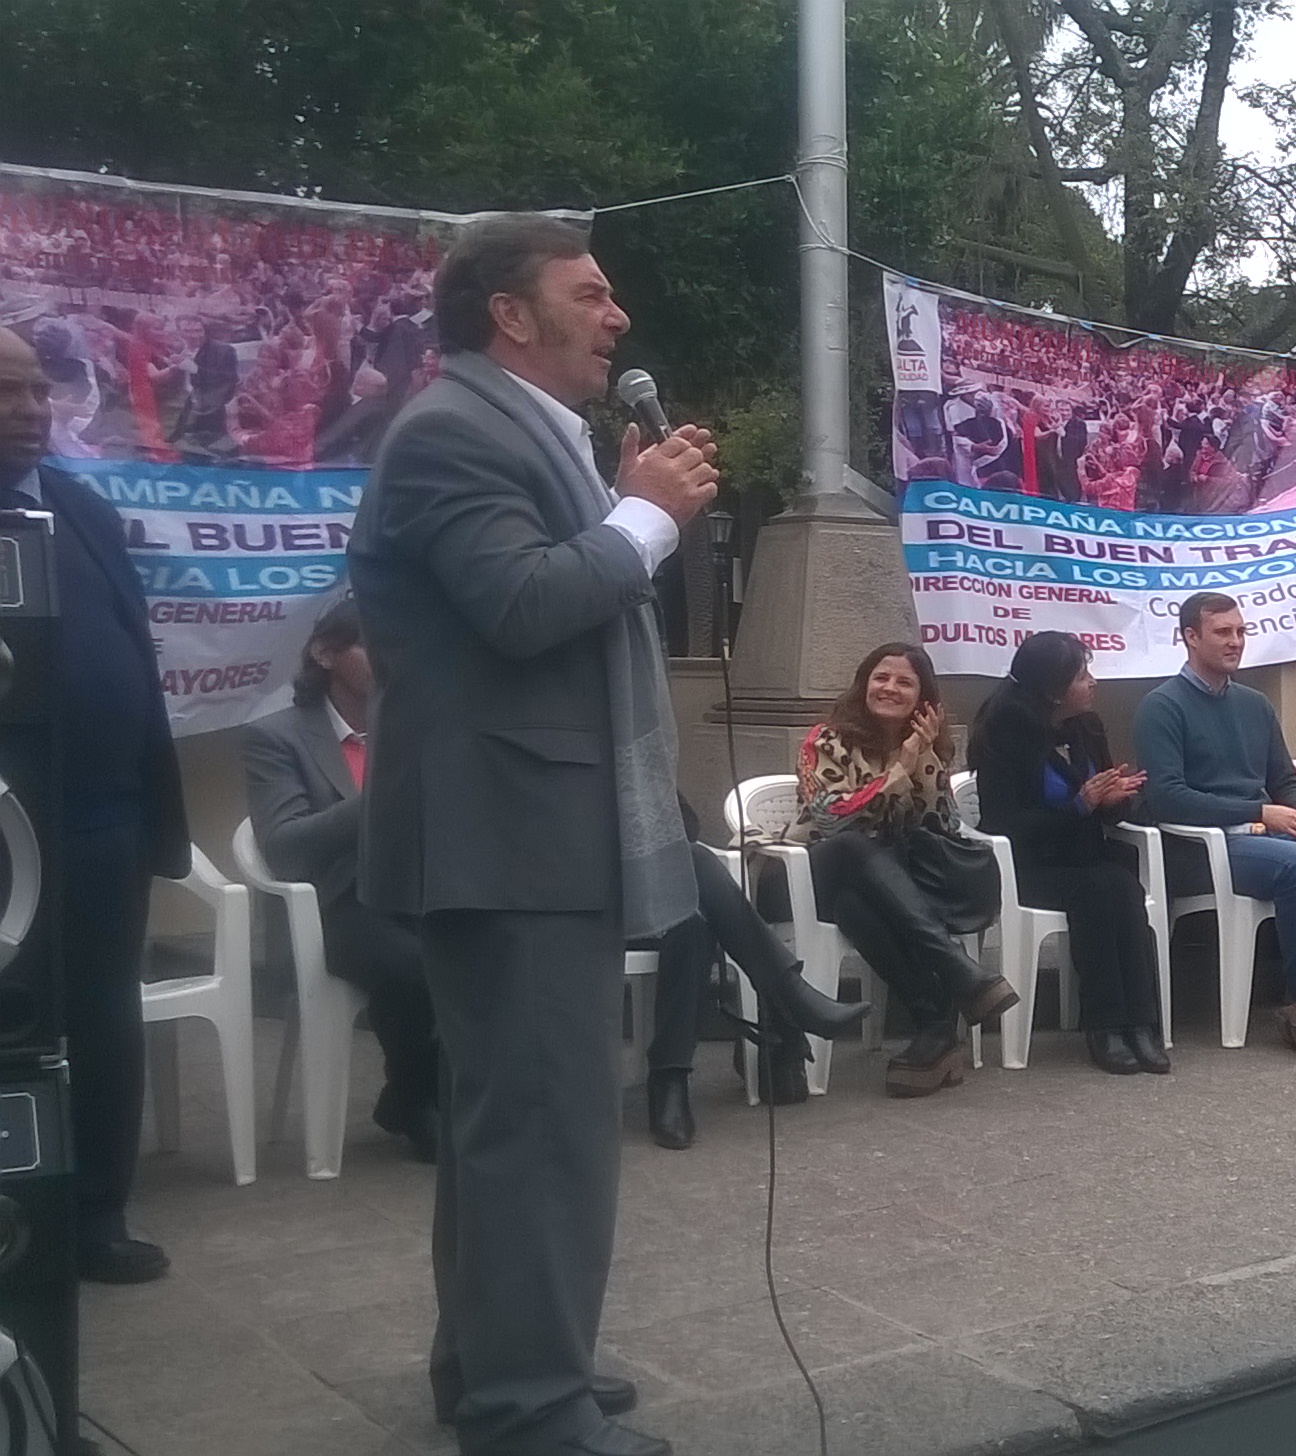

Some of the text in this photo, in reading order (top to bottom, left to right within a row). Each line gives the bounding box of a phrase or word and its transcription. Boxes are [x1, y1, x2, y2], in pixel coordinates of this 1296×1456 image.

[75, 473, 302, 508] AMPAÑA
[923, 491, 1125, 535] CAMPAÑA
[926, 519, 1024, 551] DEL
[1044, 532, 1176, 564] BUEN
[226, 564, 338, 591] LOS
[928, 550, 1058, 579] HACIA
[1071, 565, 1148, 588] LOS
[1018, 585, 1118, 605] GENERAL
[150, 601, 287, 625] GENERAL
[992, 605, 1032, 621] DE
[921, 623, 1127, 652] DULTOS MRES
[161, 660, 272, 697] AYORES
